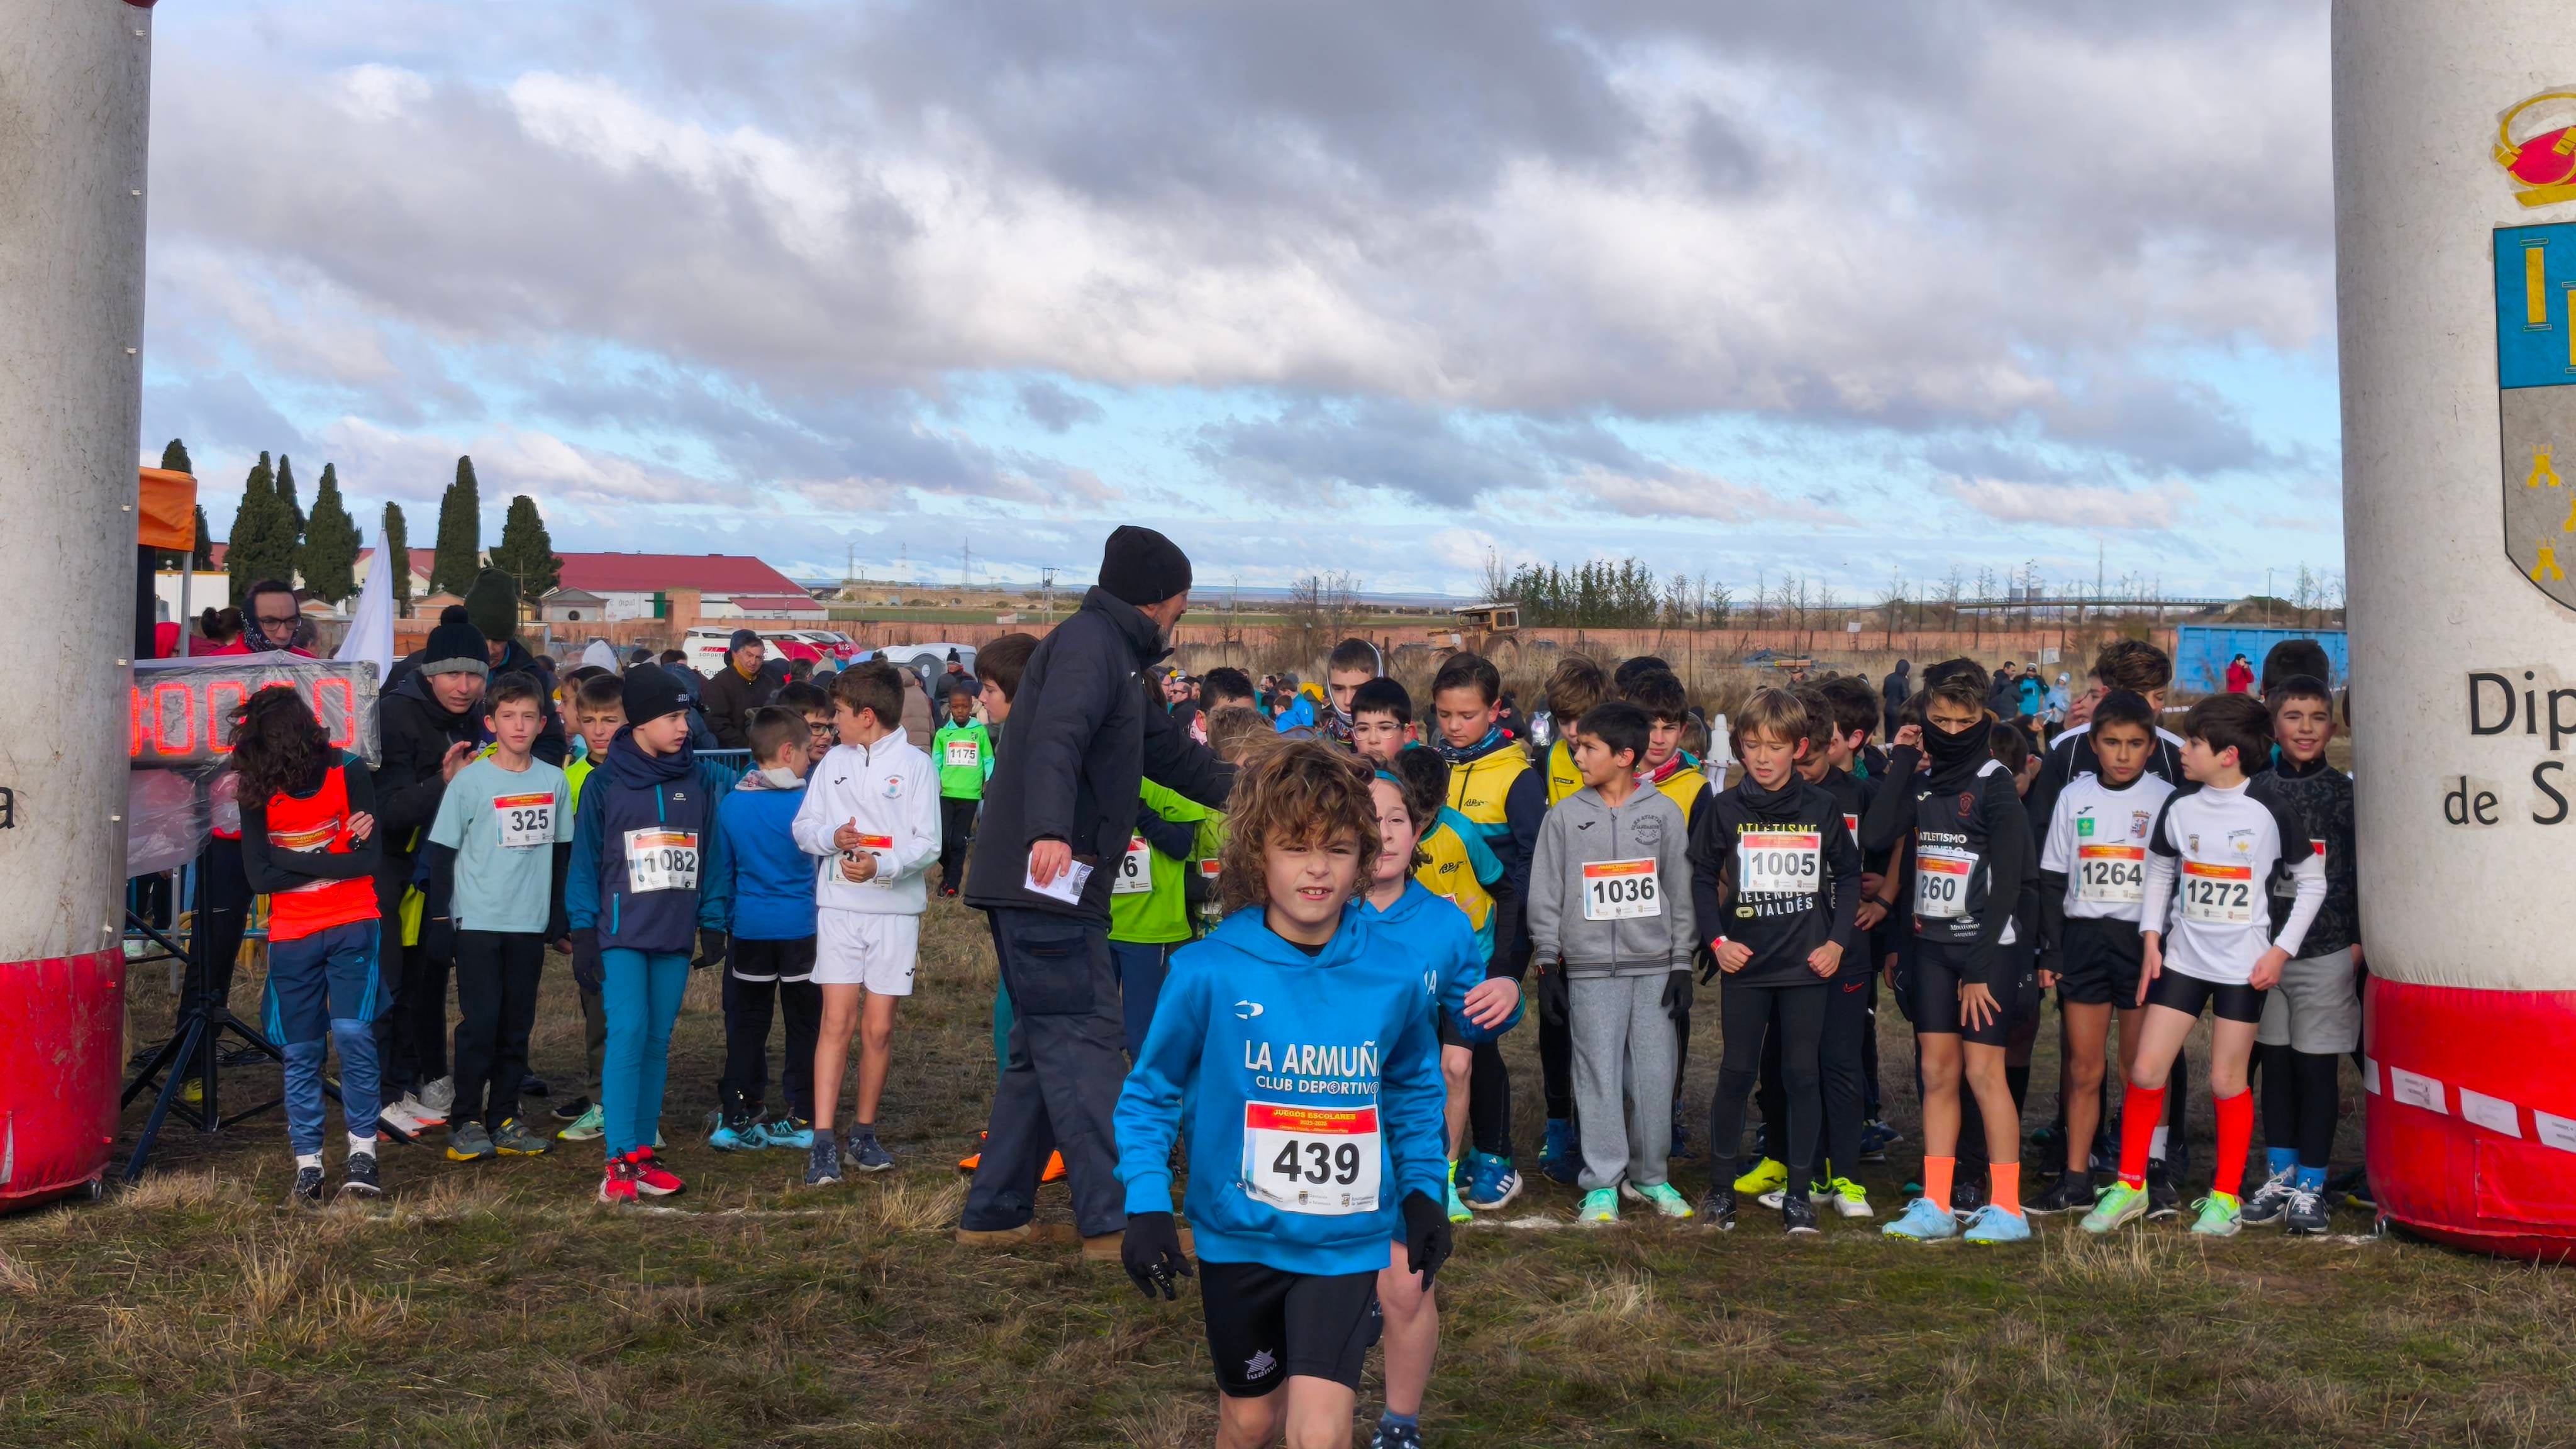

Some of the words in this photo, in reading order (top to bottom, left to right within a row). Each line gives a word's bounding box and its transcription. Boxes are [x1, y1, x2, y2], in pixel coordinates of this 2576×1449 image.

[950, 748, 975, 759] 1175
[2444, 775, 2500, 825] de
[2533, 761, 2568, 825] S
[511, 808, 549, 831] 325
[644, 849, 696, 873] 1082
[1752, 852, 1816, 876] 1005
[2082, 862, 2143, 886] 1264
[1594, 877, 1655, 904] 1036
[1922, 875, 1956, 902] 260
[2187, 879, 2248, 906] 1272
[1755, 896, 1814, 917] VALDÉS
[1245, 1040, 1273, 1072] LA
[1281, 1040, 1379, 1077] ARMUÑ
[1256, 1075, 1293, 1091] CLUB
[1298, 1079, 1379, 1095] DEPORTIVO
[1274, 1109, 1306, 1118] JUEGOS
[1272, 1140, 1360, 1185] 439
